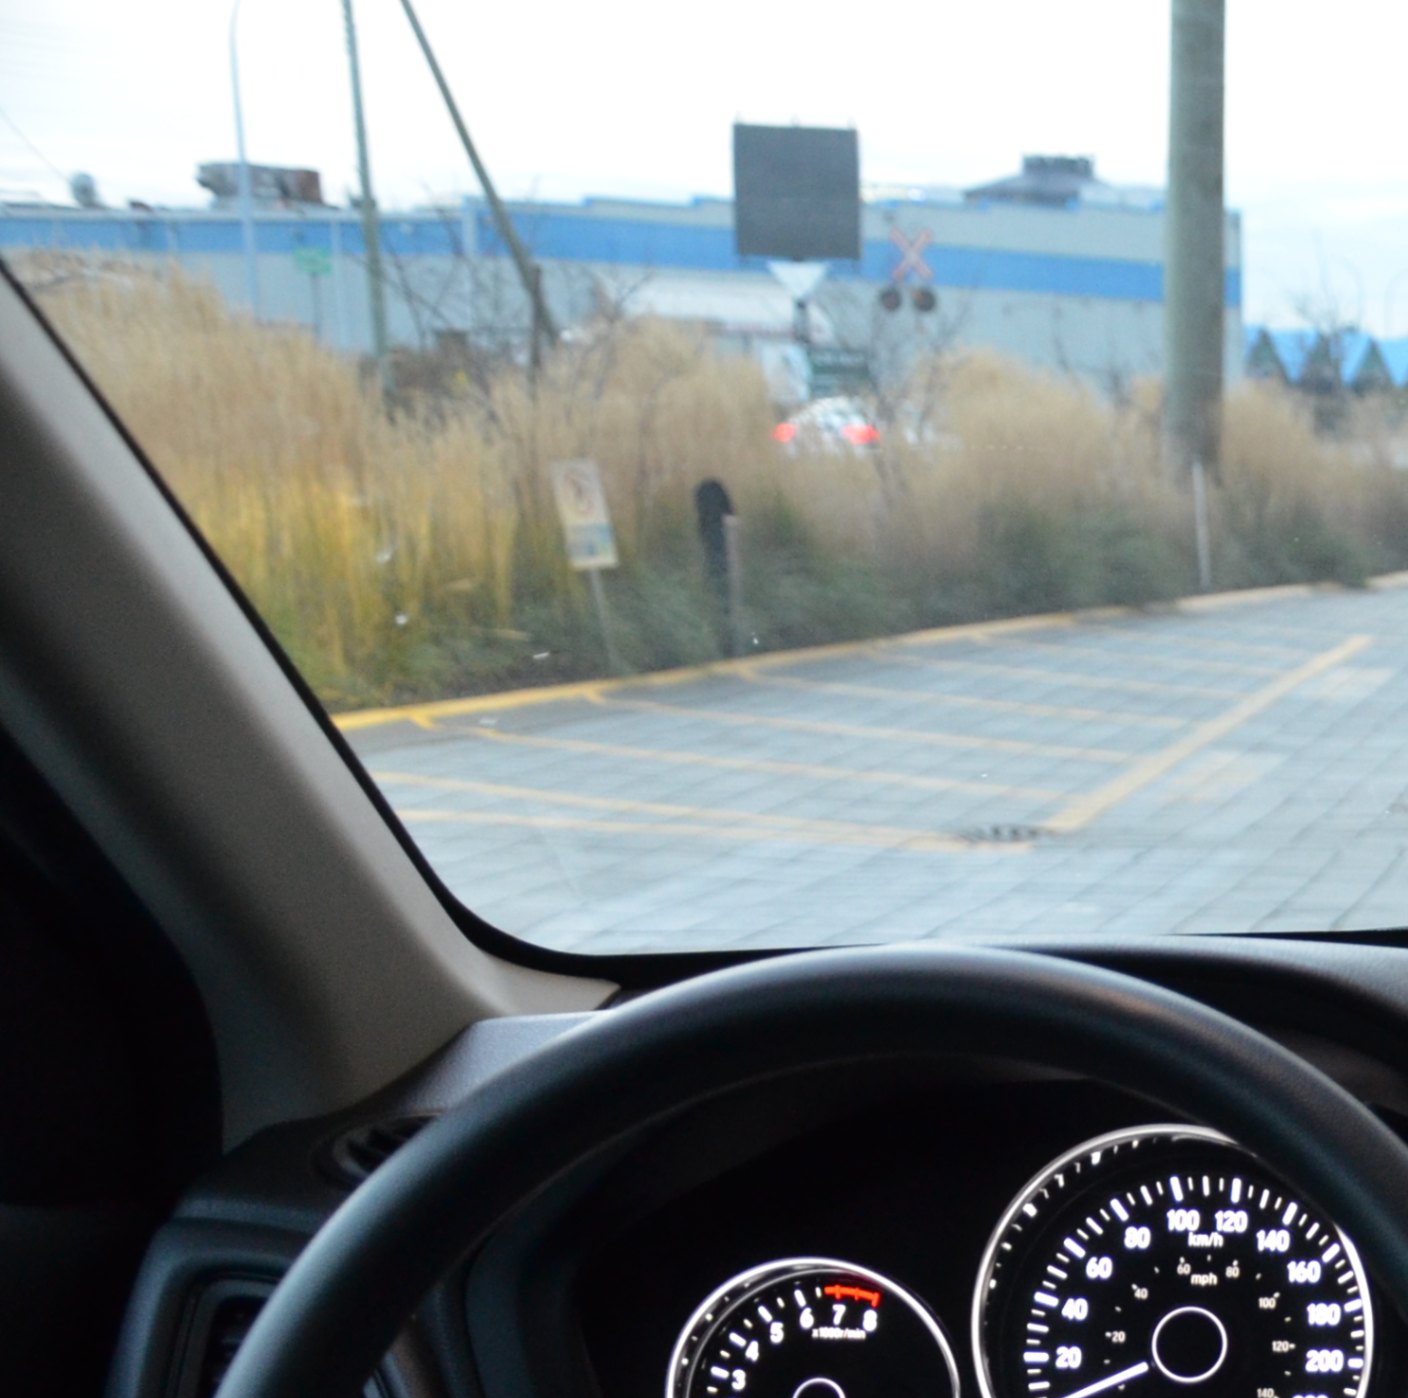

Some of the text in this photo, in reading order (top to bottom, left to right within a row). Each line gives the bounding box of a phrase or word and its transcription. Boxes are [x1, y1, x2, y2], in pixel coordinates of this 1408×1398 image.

[1167, 1209, 1200, 1232] 100
[1214, 1211, 1248, 1233] 120
[1124, 1226, 1151, 1249] 80
[1188, 1231, 1224, 1248] km/h
[1256, 1230, 1290, 1252] 140
[1086, 1257, 1113, 1280] 60
[1177, 1263, 1191, 1276] 60
[1190, 1273, 1217, 1286] mph
[1225, 1266, 1240, 1279] 80
[1287, 1260, 1321, 1284] 160
[1134, 1288, 1149, 1300] 40
[1258, 1297, 1276, 1309] 100
[799, 1307, 814, 1330] 6
[832, 1304, 846, 1325] 7
[863, 1309, 878, 1332] 8
[1061, 1298, 1088, 1321] 40
[1306, 1303, 1341, 1326] 180
[769, 1321, 784, 1343] 5
[1112, 1331, 1126, 1343] 20
[745, 1340, 759, 1361] 4
[1272, 1340, 1290, 1352] 120
[1055, 1347, 1082, 1369] 20
[1305, 1350, 1344, 1373] 200
[731, 1369, 746, 1390] 3
